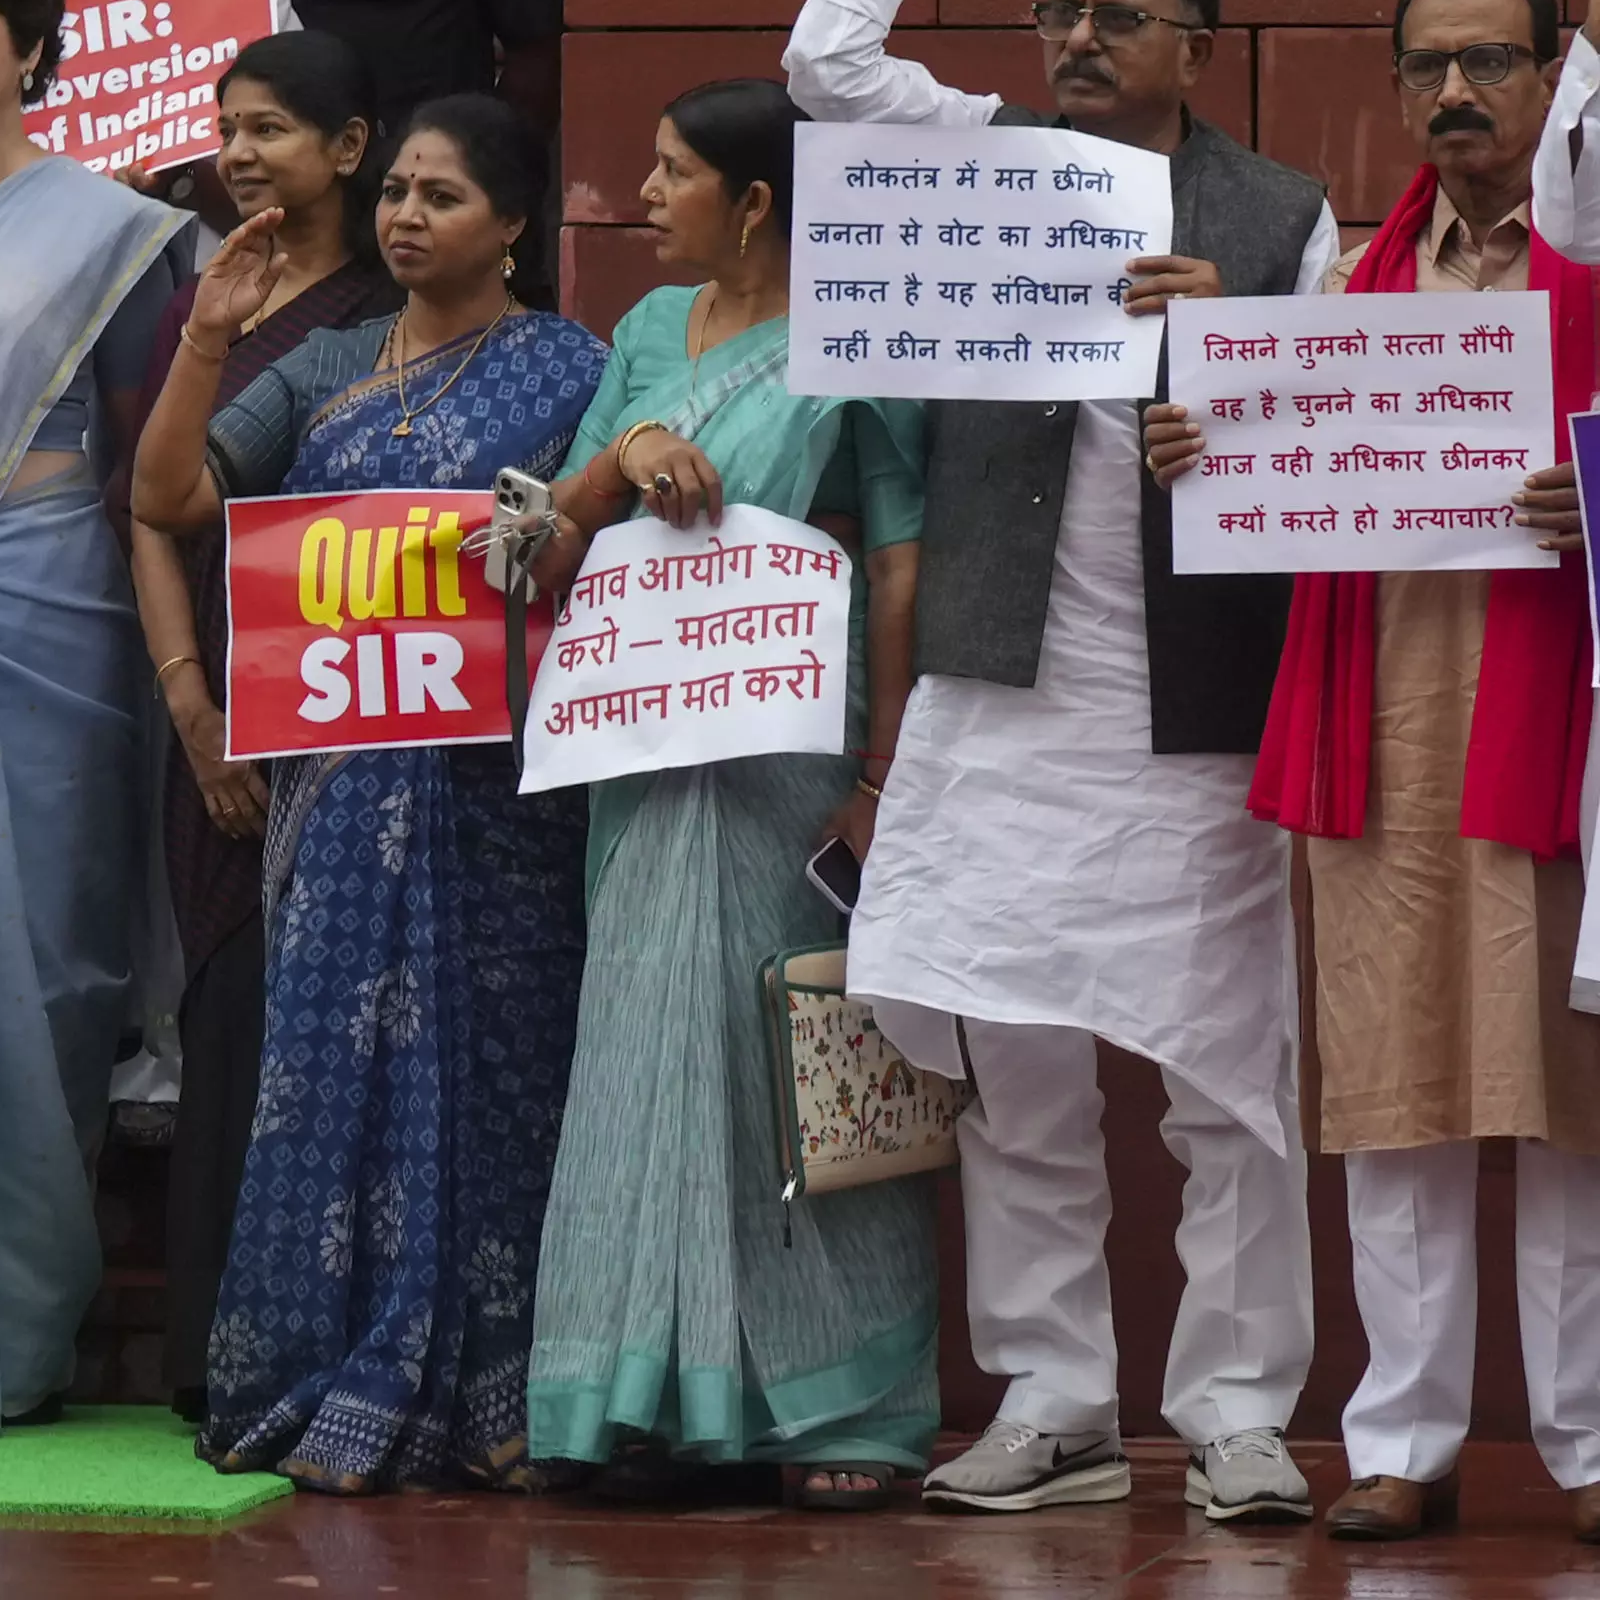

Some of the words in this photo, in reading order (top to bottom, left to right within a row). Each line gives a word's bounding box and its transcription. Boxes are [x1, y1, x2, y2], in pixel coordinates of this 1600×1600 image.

[79, 83, 215, 146] Indian
[845, 158, 941, 189] लोकतंत्र
[956, 159, 979, 189] में
[995, 169, 1037, 192] मत
[1052, 164, 1114, 194] छीनो
[809, 223, 883, 246] जनता
[899, 217, 922, 247] से
[938, 218, 984, 247] वोट
[999, 226, 1030, 248] का
[1045, 220, 1148, 251] अधिकार
[814, 279, 889, 303] ताकत
[904, 273, 922, 305] है
[938, 281, 977, 307] यह
[992, 275, 1092, 306] संविधान
[823, 329, 871, 360] नहीं
[886, 331, 940, 360] छीन
[955, 331, 1032, 363] सकती
[1046, 341, 1125, 363] सरकार
[1204, 332, 1279, 362] जिसने
[1294, 329, 1369, 370] तुमको
[1383, 333, 1445, 356] सत्ता
[1459, 324, 1515, 355] सौंपी
[1210, 397, 1246, 421] वह
[1259, 389, 1278, 421] है
[1292, 387, 1356, 427] चुनने
[1370, 391, 1401, 414] का
[1416, 384, 1513, 415] अधिकार
[1201, 454, 1256, 477] आज
[1271, 446, 1314, 478] वही
[1328, 445, 1427, 474] अधिकार
[1440, 442, 1530, 472] छीनकर
[1218, 503, 1266, 534] क्यों
[1281, 504, 1339, 533] करते
[1353, 502, 1378, 533] हो
[1392, 505, 1515, 531] अत्याचार?
[298, 507, 467, 632] Quit
[638, 536, 757, 592] आयोग
[766, 543, 843, 580] शर्म
[557, 616, 620, 673] करो
[675, 601, 819, 650] मतदाता
[297, 632, 473, 723] SIR
[545, 684, 671, 736] अपमान
[680, 672, 734, 713] मत
[743, 650, 826, 702] करो
